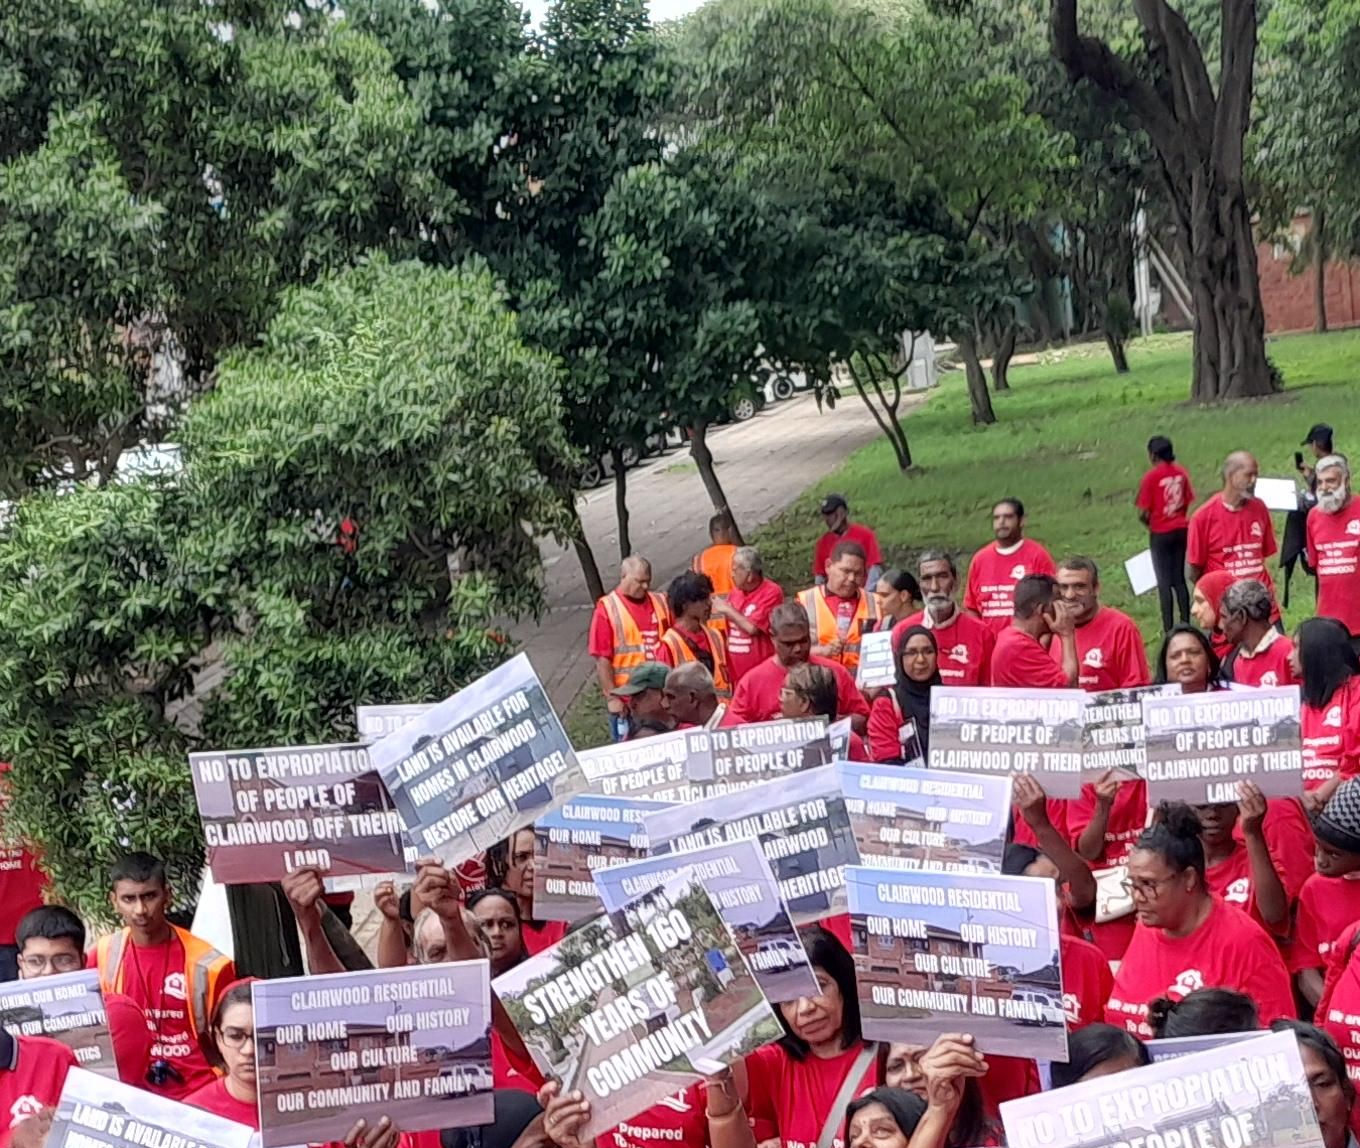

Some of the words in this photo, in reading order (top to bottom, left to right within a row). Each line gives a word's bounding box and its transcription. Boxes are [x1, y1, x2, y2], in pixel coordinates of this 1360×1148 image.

[397, 753, 428, 783] LAND
[427, 741, 442, 764] IS
[443, 704, 503, 754] AVAILABLE
[502, 691, 529, 721] FOR
[1176, 730, 1195, 751] OF
[1198, 728, 1249, 749] PEOPLE
[1252, 725, 1270, 745] OF
[199, 760, 225, 783] NO
[228, 757, 252, 780] TO
[410, 773, 456, 807] HOMES
[453, 761, 470, 784] IN
[468, 721, 537, 774] CLAIRWOOD
[1148, 757, 1229, 781] CLAIRWOOD
[1232, 754, 1259, 775] OFF
[1261, 750, 1302, 771] THEIR
[236, 792, 259, 813] OF
[265, 786, 330, 811] PEOPLE
[334, 782, 356, 806] OF
[422, 802, 479, 849] RESTORE
[476, 786, 505, 818] OUR
[503, 750, 567, 805] HERITAGE!
[205, 820, 309, 847] CLAIRWOOD
[312, 816, 344, 839] OFF
[878, 883, 945, 906] CLAIRWOOD
[948, 888, 1022, 912] RESIDENTIAL
[867, 916, 890, 935] OUR
[892, 920, 928, 939] HOME
[960, 923, 985, 943] OUR
[988, 926, 1037, 947] HISTORY
[524, 935, 652, 1025] STRENGTHEN
[646, 909, 691, 954] 160
[914, 953, 938, 972] OUR
[940, 955, 992, 978] CULTURE
[291, 988, 370, 1011] CLAIRWOOD
[374, 978, 455, 1003] RESIDENTIAL
[579, 990, 651, 1047] YEARS
[645, 971, 678, 1013] OF
[872, 986, 896, 1006] OUR
[898, 988, 968, 1013] COMMUNITY
[971, 996, 996, 1016] AND
[998, 998, 1044, 1020] FAMILY
[276, 1025, 304, 1044] OUR
[306, 1020, 348, 1041] HOME
[386, 1015, 413, 1034] OUR
[415, 1008, 470, 1029] HISTORY
[330, 1052, 357, 1071] OUR
[361, 1045, 418, 1068] CULTURE
[587, 1006, 713, 1099] COMMUNITY
[277, 1092, 305, 1113] OUR
[307, 1083, 390, 1110] COMMUNITY
[394, 1078, 421, 1099] AND
[424, 1073, 472, 1096] FAMILY
[1017, 1111, 1056, 1148] NO
[1059, 1101, 1095, 1139] TO
[1100, 1053, 1290, 1131] EXPROPIATION
[71, 1102, 110, 1131] LAND
[108, 1114, 124, 1137] IS
[619, 1122, 684, 1141] Prepared
